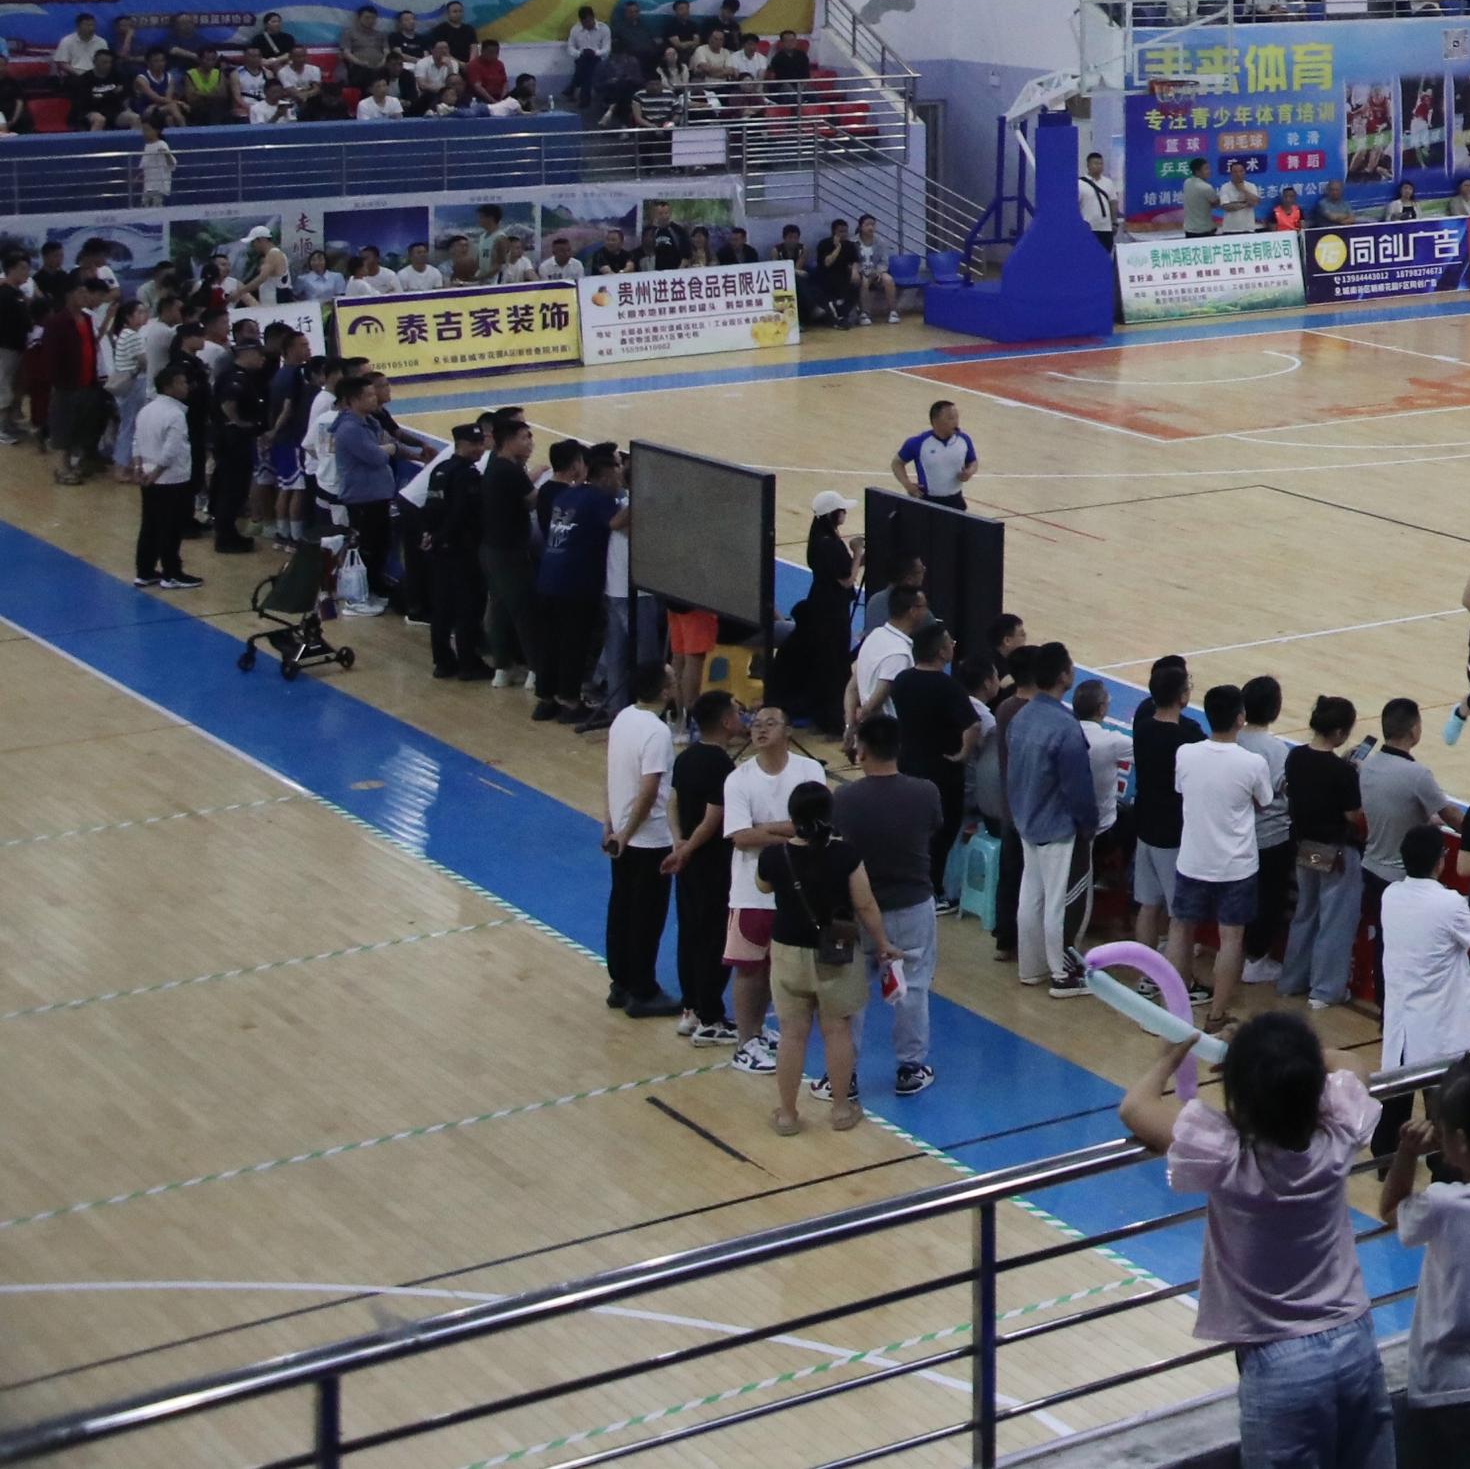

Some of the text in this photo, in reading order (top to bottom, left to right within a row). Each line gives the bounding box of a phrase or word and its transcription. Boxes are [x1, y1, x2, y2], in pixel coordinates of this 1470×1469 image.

[1144, 101, 1336, 132] 专注青少年体育培训
[1165, 135, 1201, 153] 篮球
[1287, 154, 1321, 170] 舞蹈
[1349, 229, 1460, 266] 同创广告
[617, 268, 788, 307] 贵州进益食品有限公司
[396, 302, 571, 345] 泰吉家装饰
